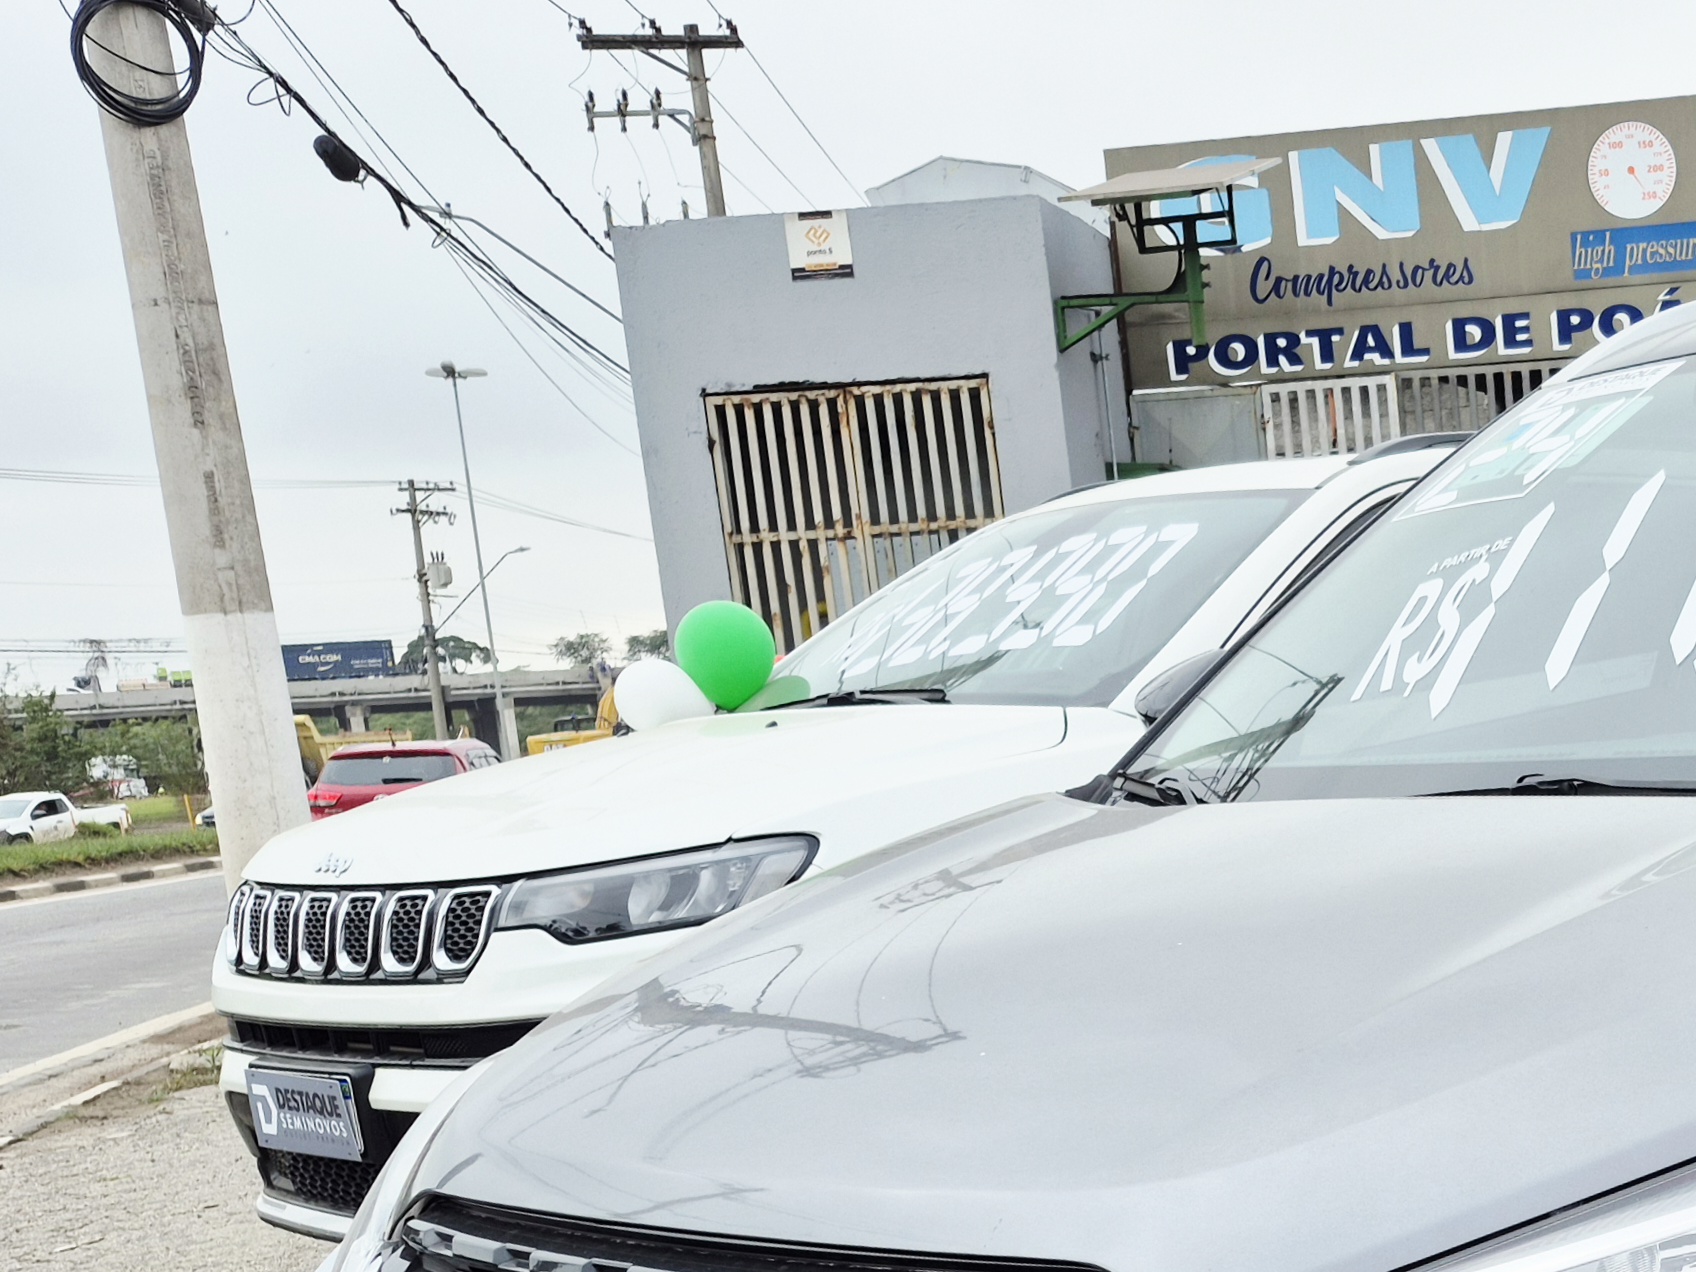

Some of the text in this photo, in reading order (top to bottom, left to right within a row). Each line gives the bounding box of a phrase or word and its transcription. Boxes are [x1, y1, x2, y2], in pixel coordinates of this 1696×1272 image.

[1607, 141, 1624, 150] 100
[1637, 140, 1654, 149] 150
[1598, 168, 1610, 178] 50
[1647, 164, 1665, 173] 200
[1641, 191, 1658, 201] 250
[1573, 231, 1615, 279] high
[1249, 256, 1475, 306] Compressores
[1167, 323, 1431, 382] PORTAL
[1446, 312, 1535, 360] DE
[1439, 544, 1490, 571] PARTIR
[1490, 536, 1514, 553] DE
[274, 1086, 342, 1120] DESTAQUE
[279, 1111, 348, 1139] SEMINOVOS
